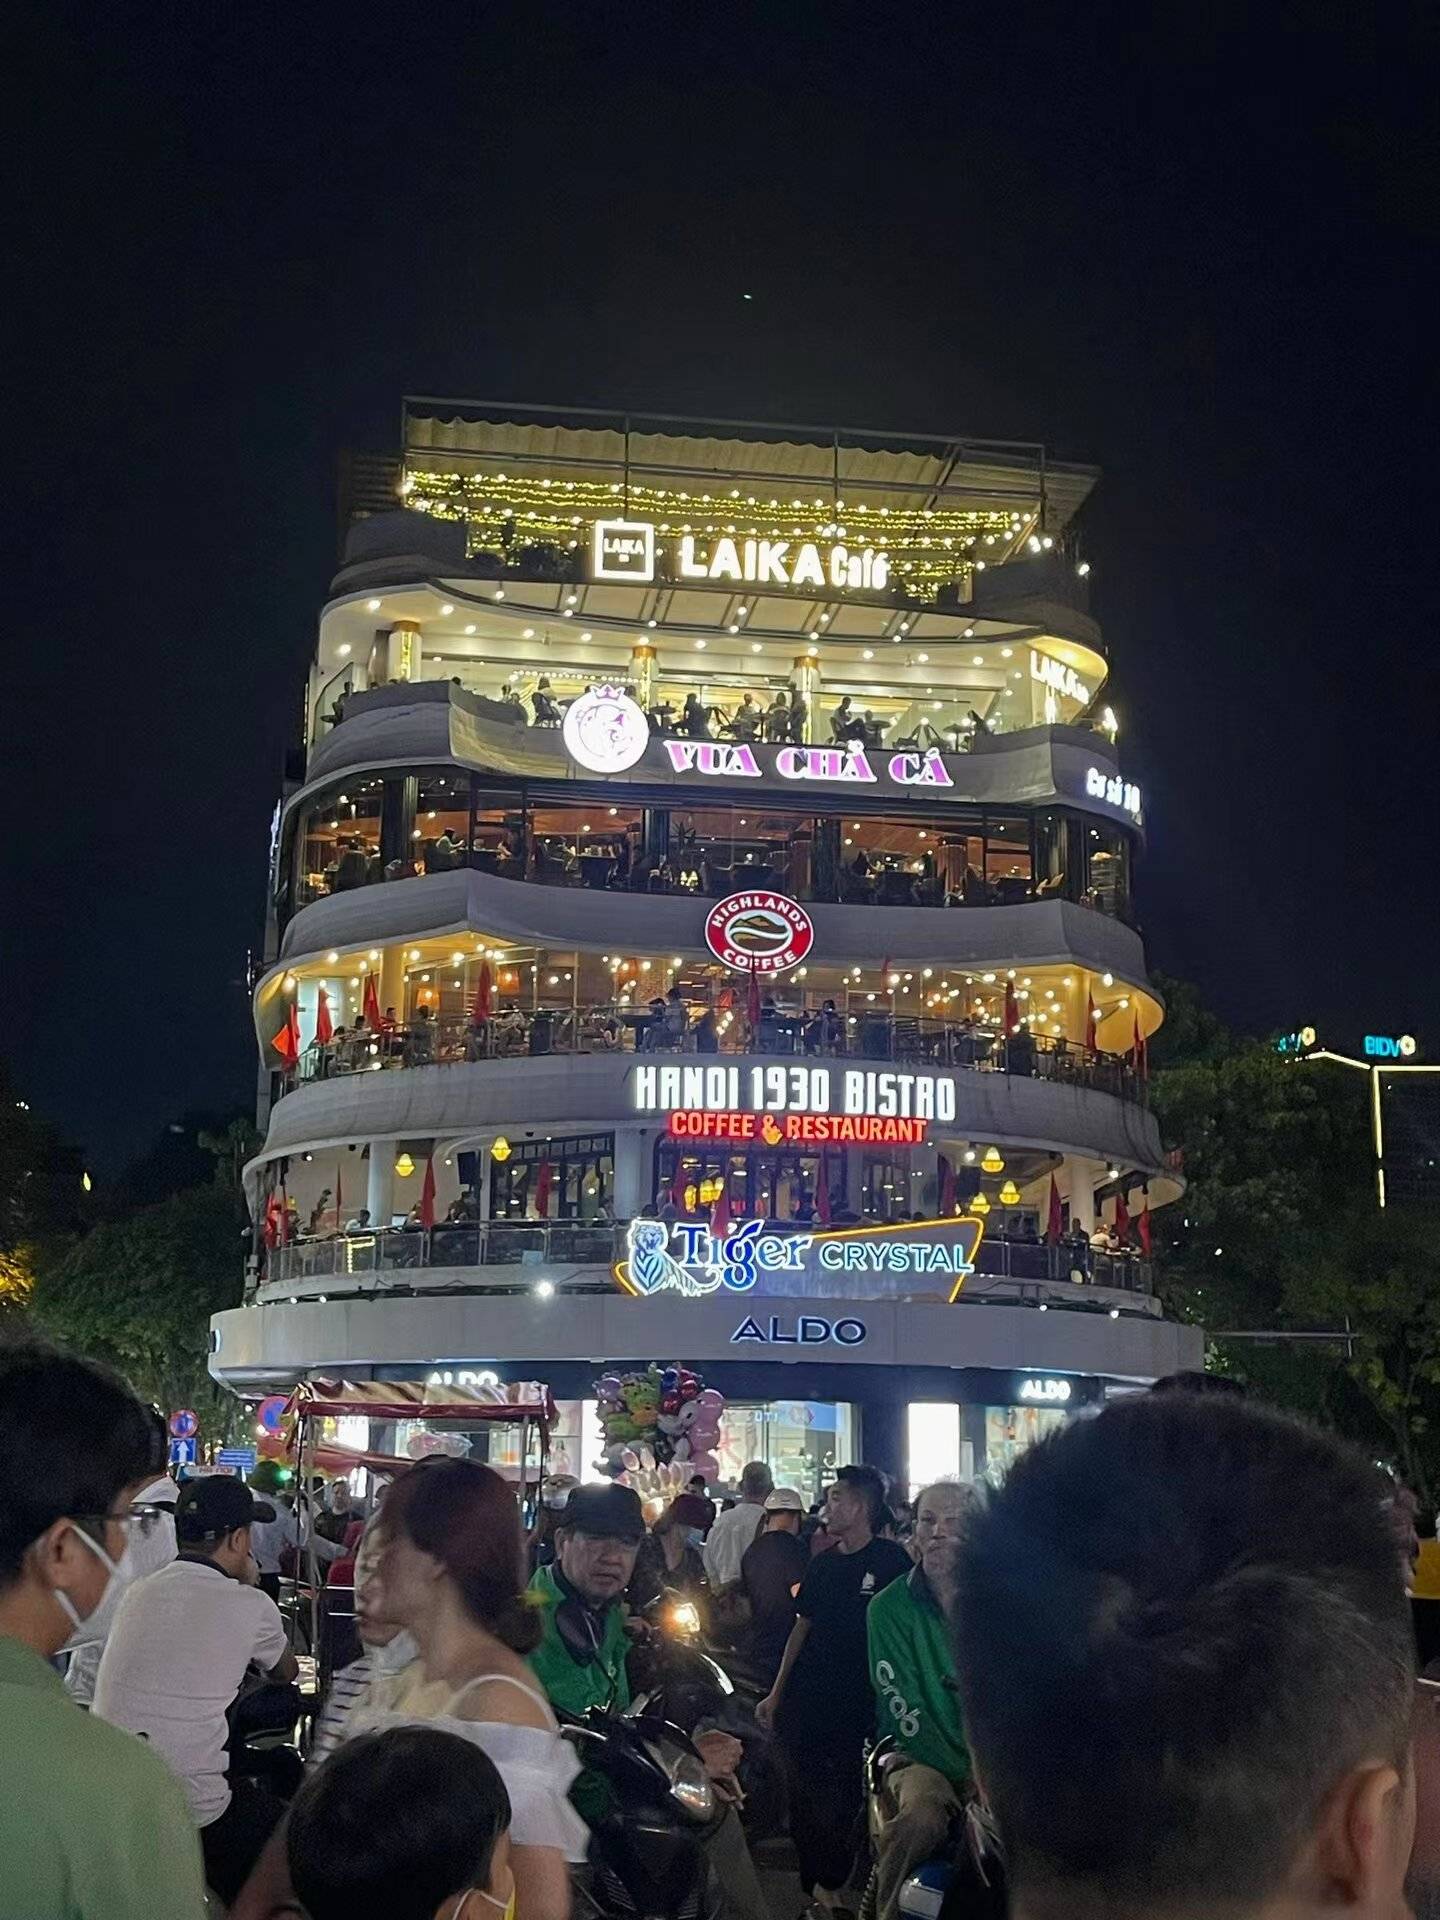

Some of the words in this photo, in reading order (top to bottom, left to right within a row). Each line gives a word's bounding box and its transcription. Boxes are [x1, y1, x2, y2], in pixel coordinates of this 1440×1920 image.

[681, 535, 826, 586] LAIKA
[831, 546, 889, 590] Café
[663, 740, 763, 777] VUA
[776, 738, 878, 783] CHẢ
[888, 747, 955, 787] CÁ
[711, 896, 808, 932] HIGHLANDS
[722, 949, 798, 970] COFFEE
[1364, 1035, 1400, 1058] BIDV
[635, 1066, 739, 1110] HANOI
[751, 1066, 831, 1113] 1930
[845, 1071, 956, 1121] BISTRO
[671, 1111, 755, 1138] COFFEE
[786, 1115, 928, 1143] RESTAURANT
[672, 1219, 813, 1291] Tiger
[820, 1240, 975, 1273] CRYSTAL
[730, 1316, 867, 1345] ALDO
[1020, 1379, 1072, 1400] ALDO
[875, 1660, 921, 1737] Grab
